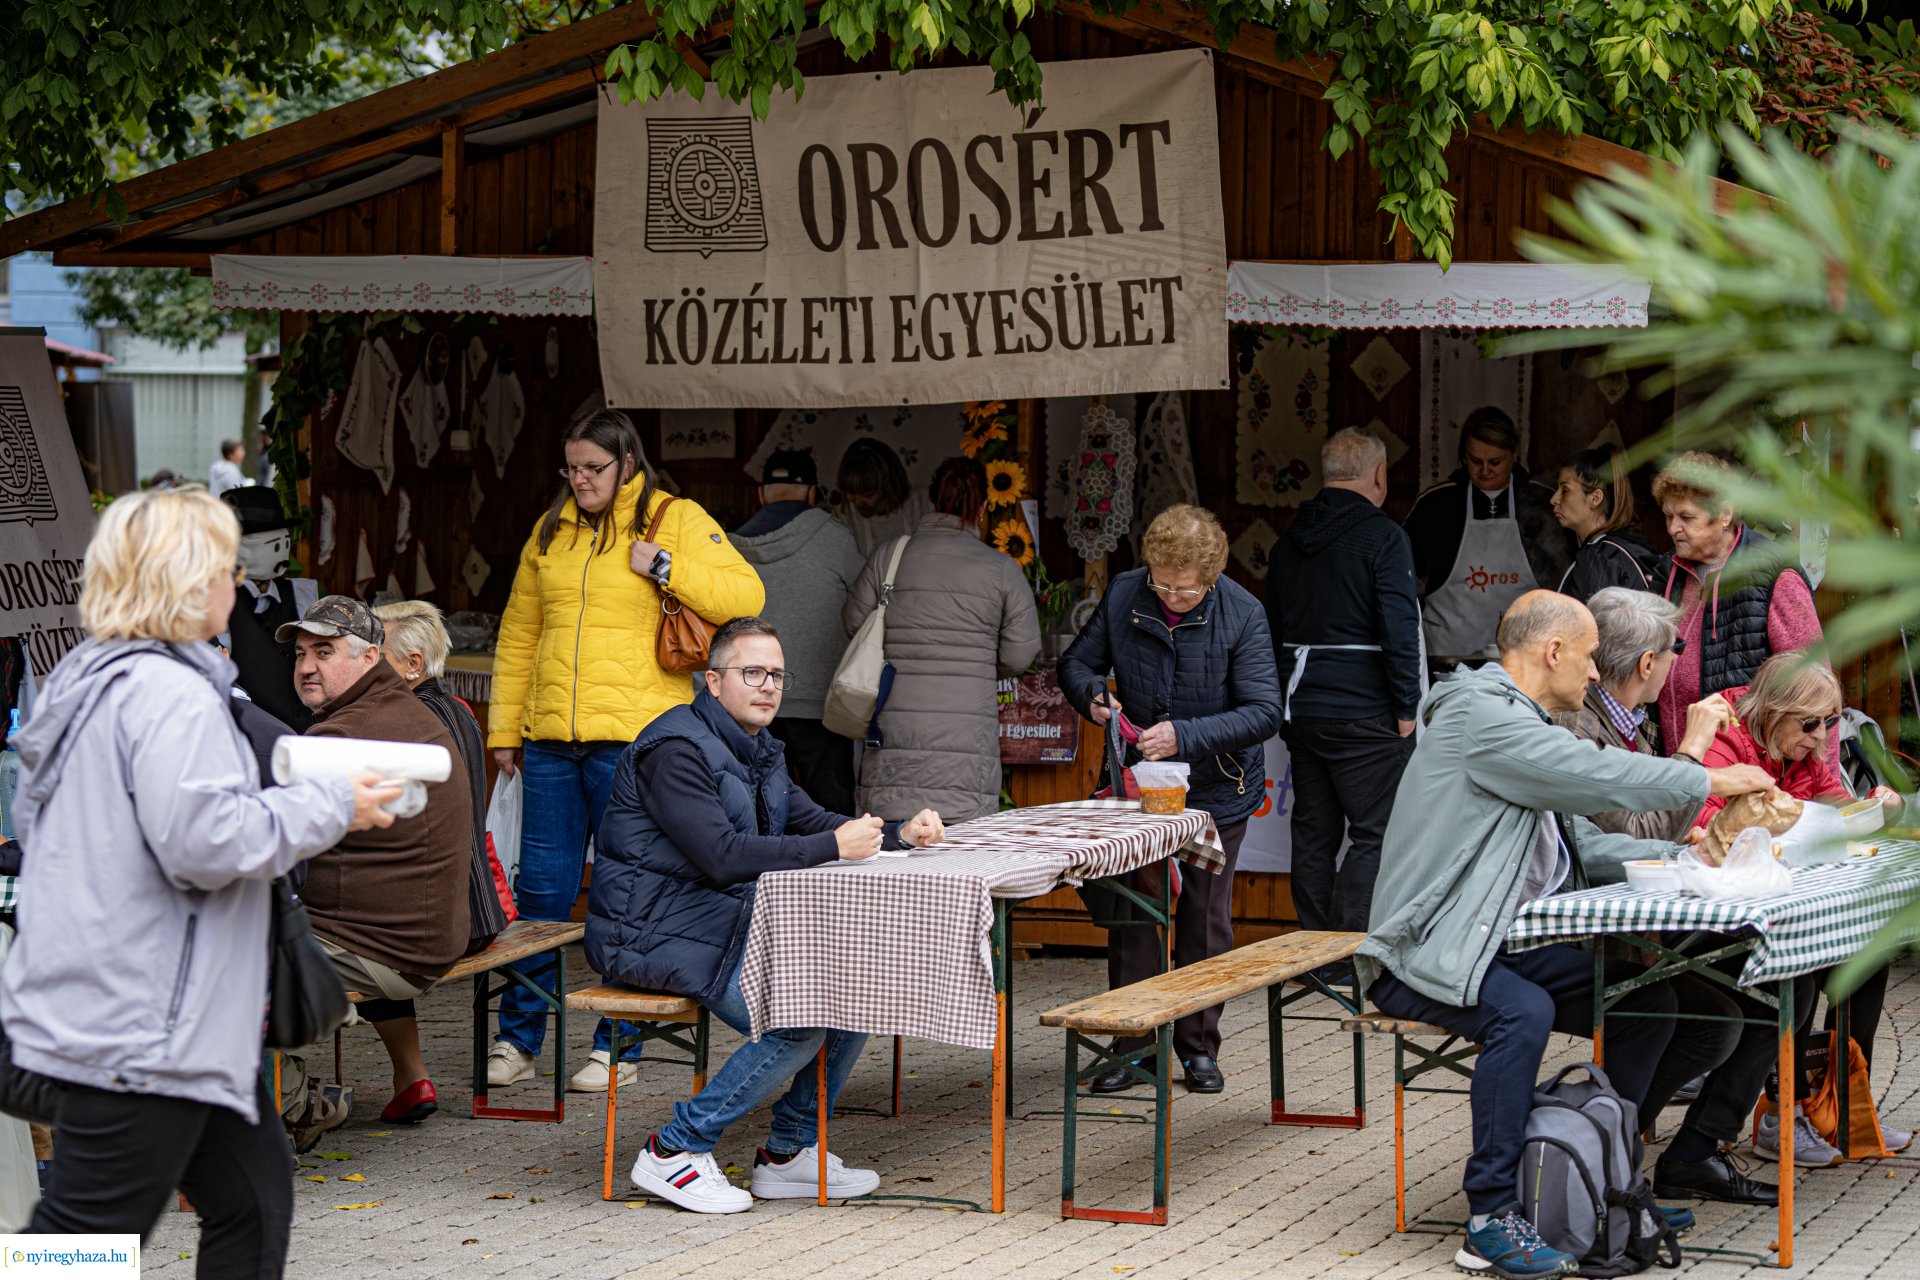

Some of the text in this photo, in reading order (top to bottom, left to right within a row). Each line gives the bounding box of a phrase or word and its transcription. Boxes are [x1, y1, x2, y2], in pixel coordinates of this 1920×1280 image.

[799, 107, 1171, 253] OROSÉRT
[644, 272, 1183, 366] KÖZÉLETI EGYESÜLET
[0, 549, 85, 611] OROSÉR
[1467, 568, 1519, 589] Oros
